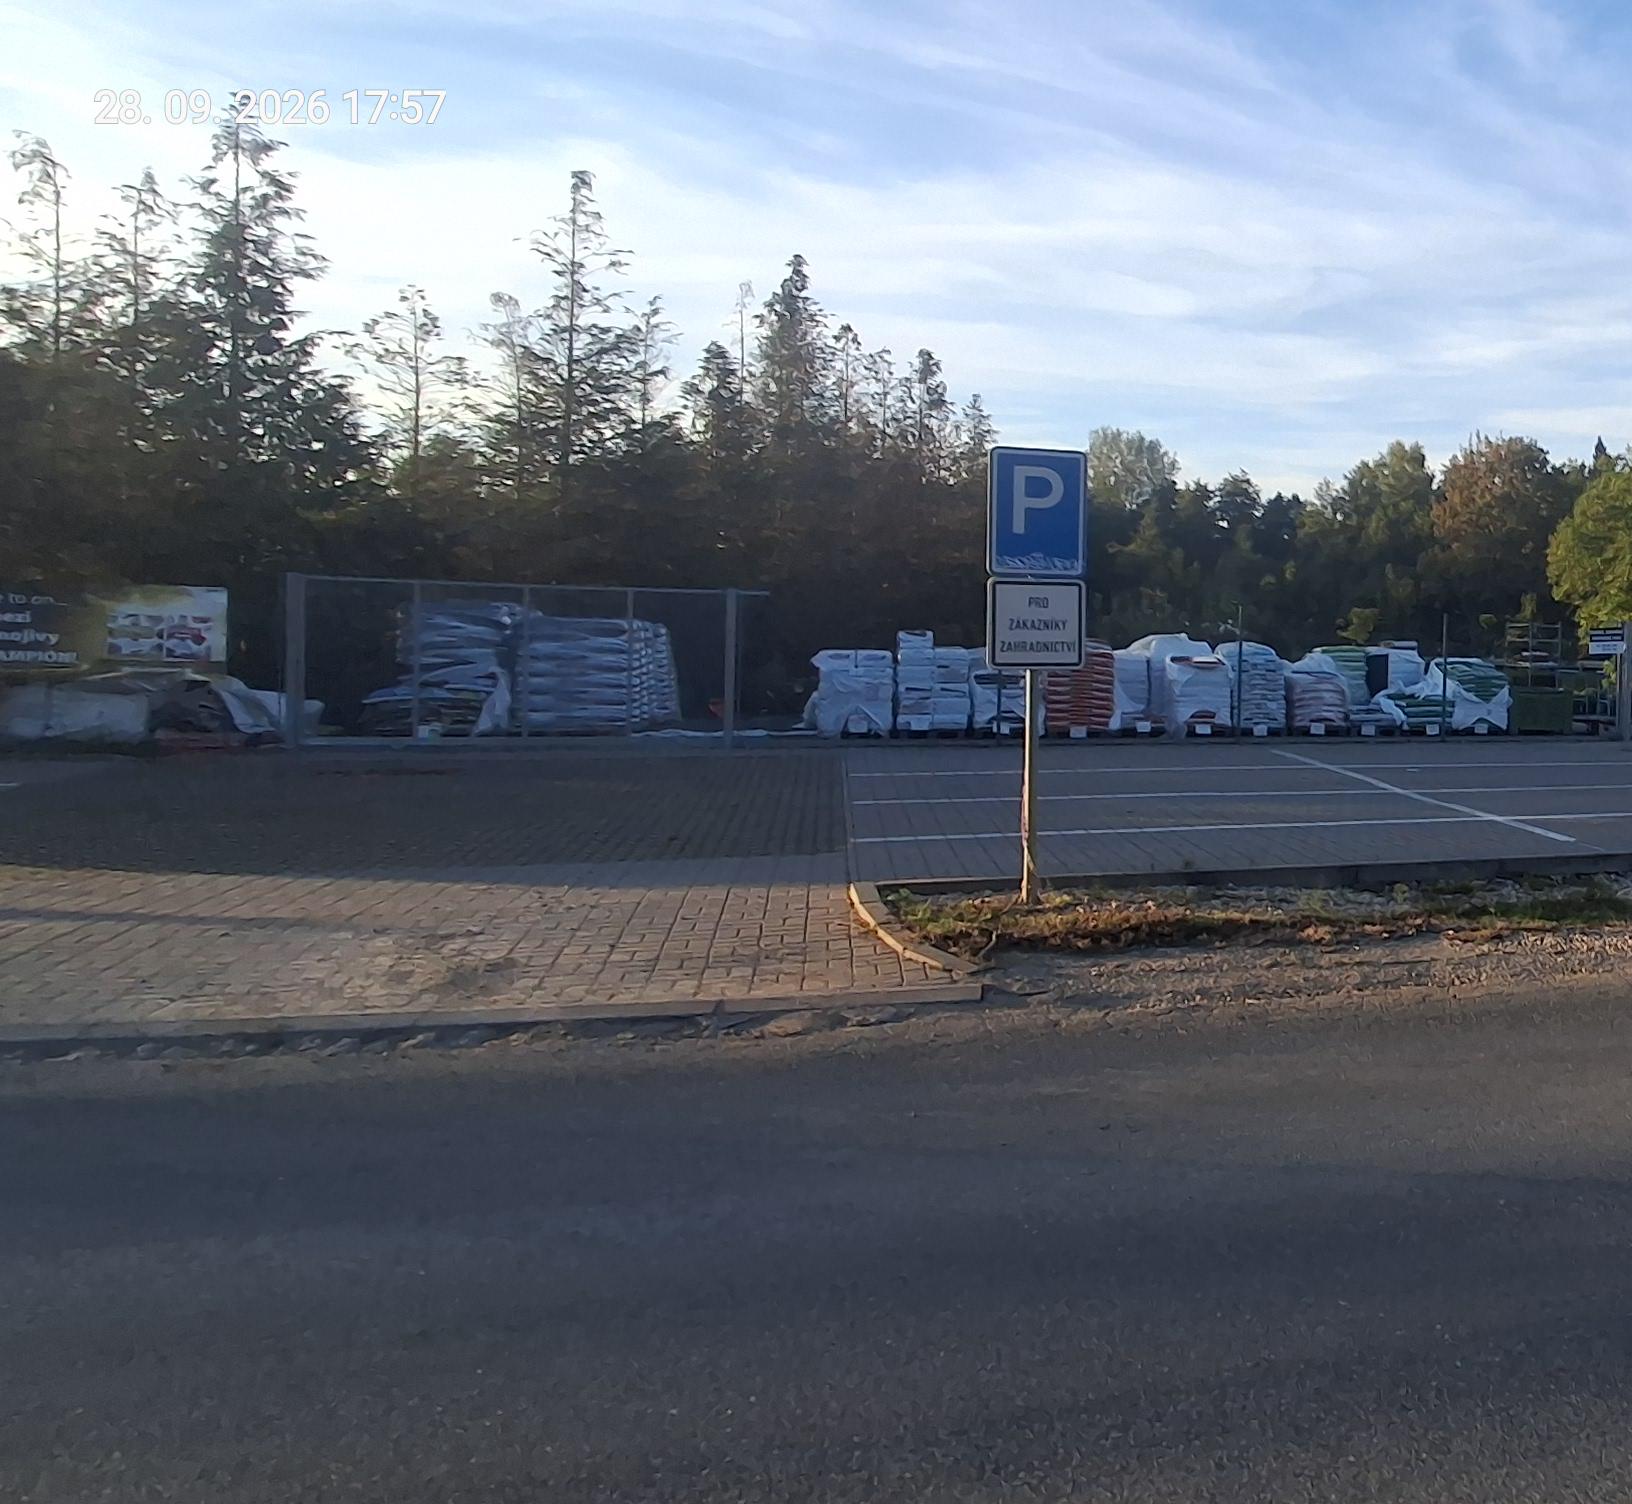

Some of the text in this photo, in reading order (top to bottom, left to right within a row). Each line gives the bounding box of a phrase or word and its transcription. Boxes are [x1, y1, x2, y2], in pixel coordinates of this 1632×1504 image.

[1012, 465, 1064, 535] P
[1028, 596, 1049, 609] PRO
[1008, 616, 1068, 631] ZÁKAZNÍKY
[1000, 640, 1076, 653] ZAHRADNICTVÍ
